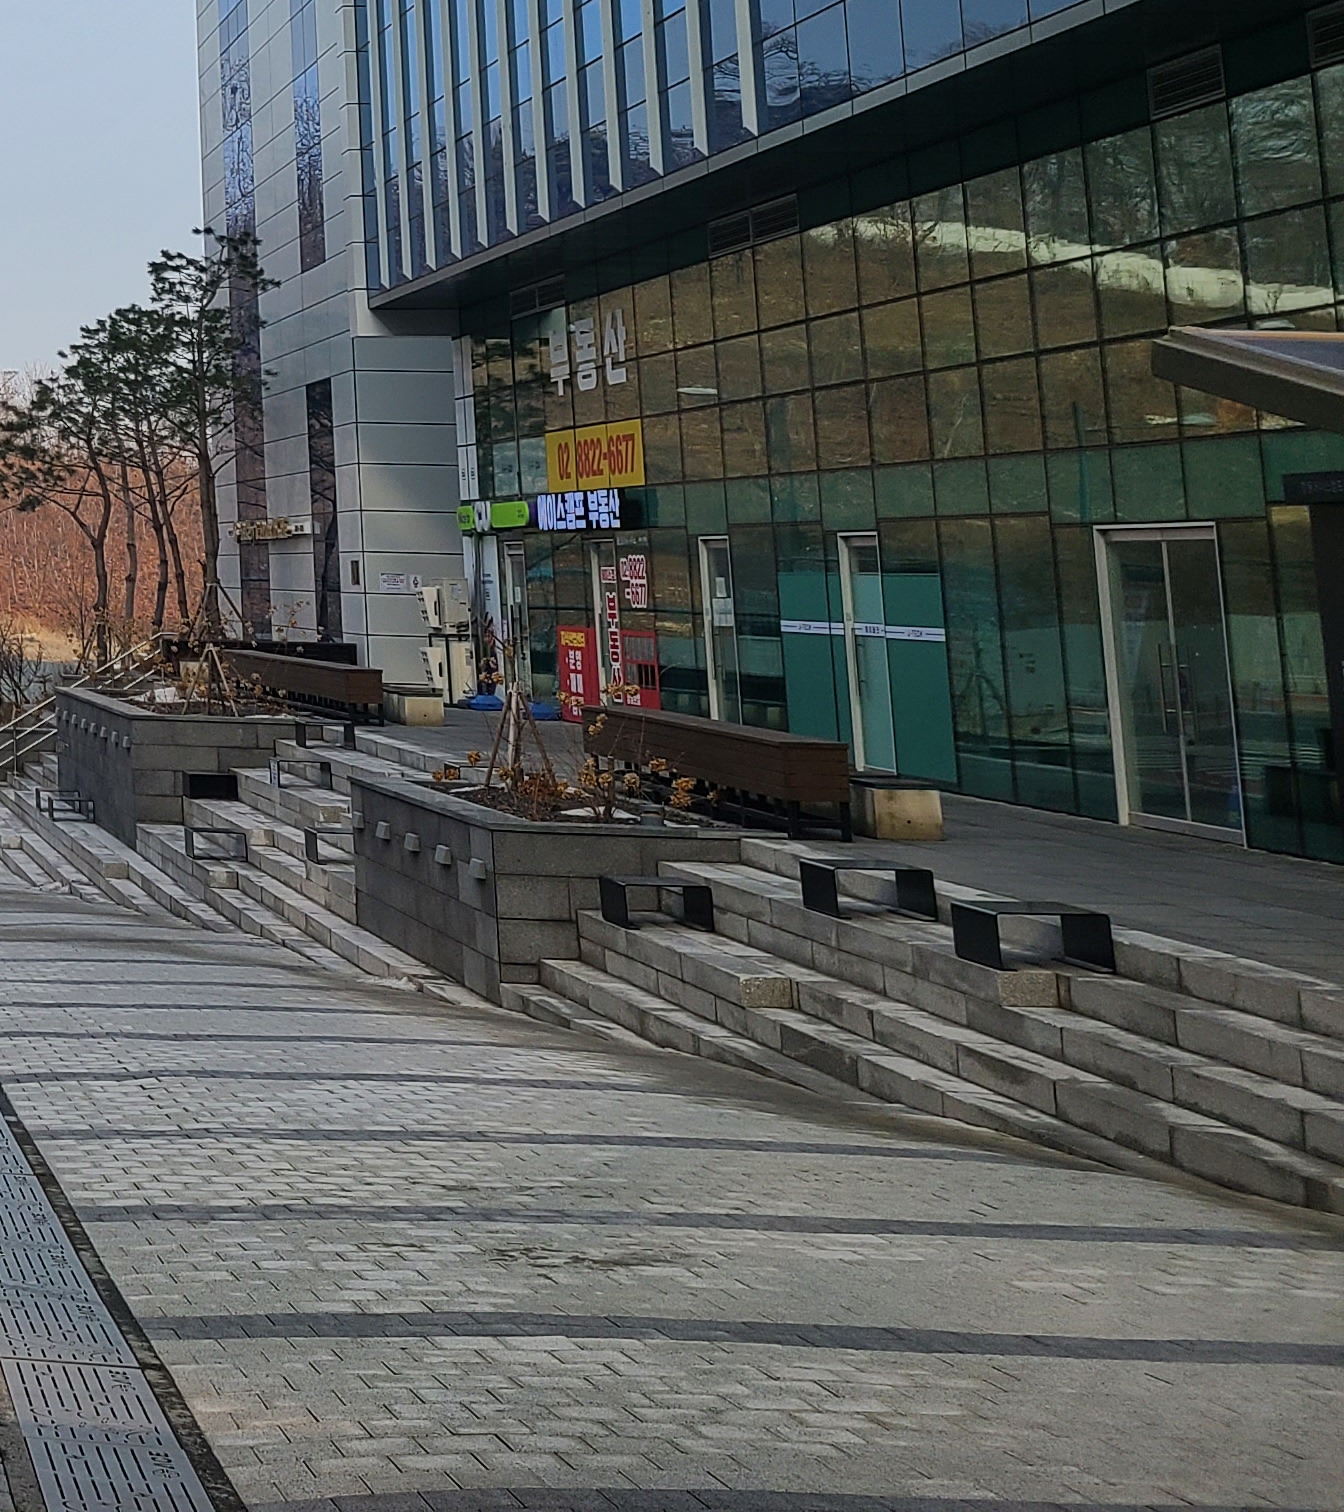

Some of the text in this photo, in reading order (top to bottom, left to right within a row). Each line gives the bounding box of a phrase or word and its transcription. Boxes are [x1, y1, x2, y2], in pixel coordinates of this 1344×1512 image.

[549, 309, 627, 396] 부동산
[557, 433, 636, 481] 02 8822-6677
[537, 488, 621, 531] 에이스캠프 부동산
